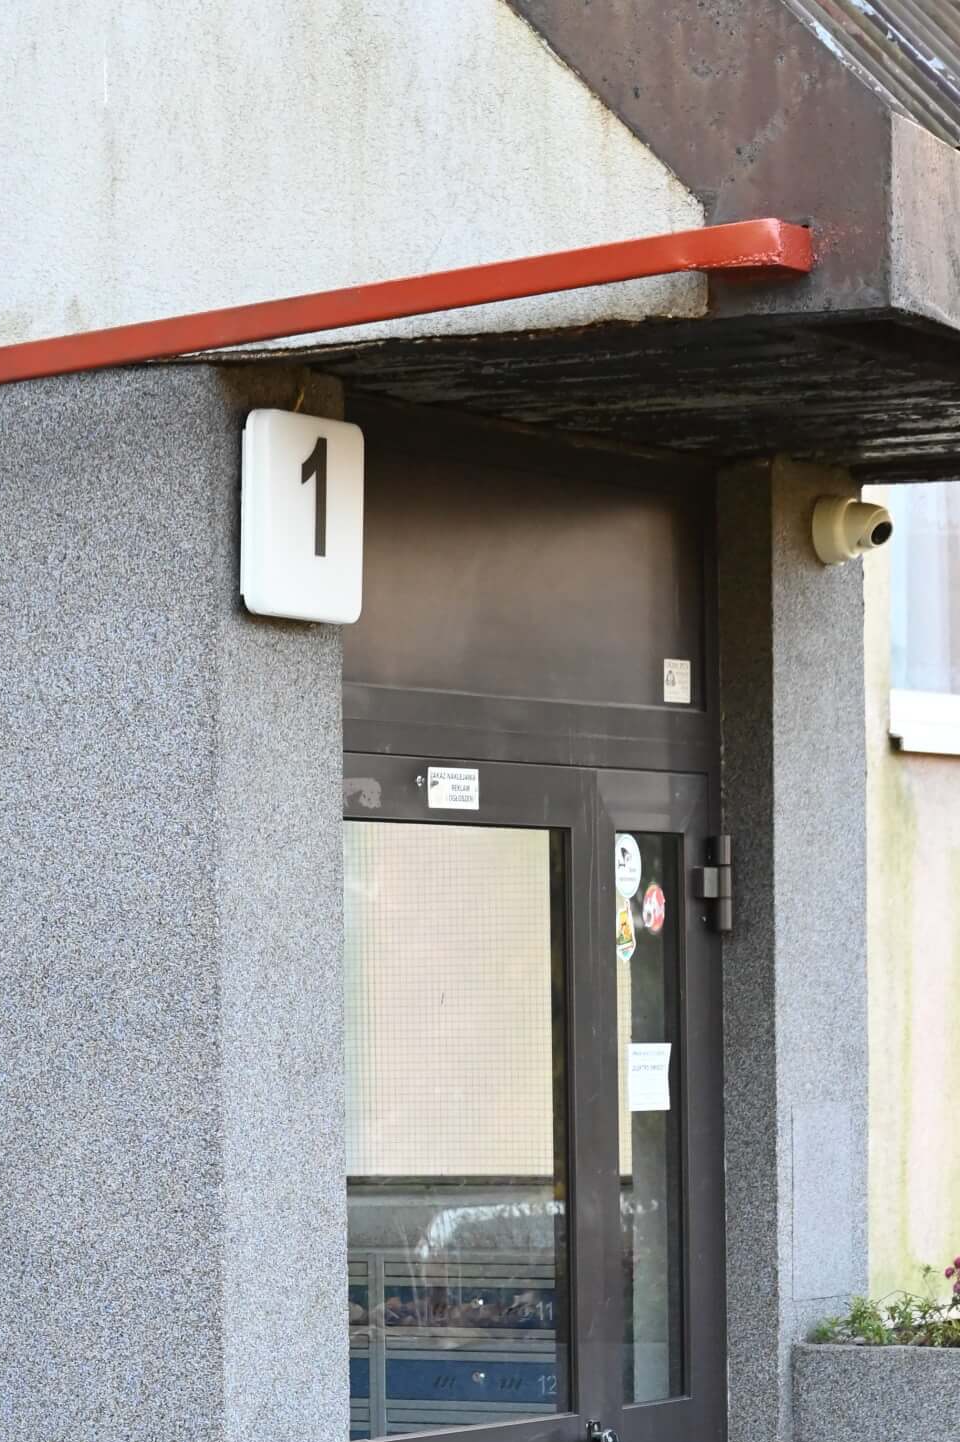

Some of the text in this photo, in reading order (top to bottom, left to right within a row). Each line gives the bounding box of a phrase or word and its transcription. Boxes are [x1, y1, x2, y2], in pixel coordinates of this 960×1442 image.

[301, 437, 328, 557] 1
[535, 1301, 553, 1321] 11
[537, 1375, 557, 1395] 12
